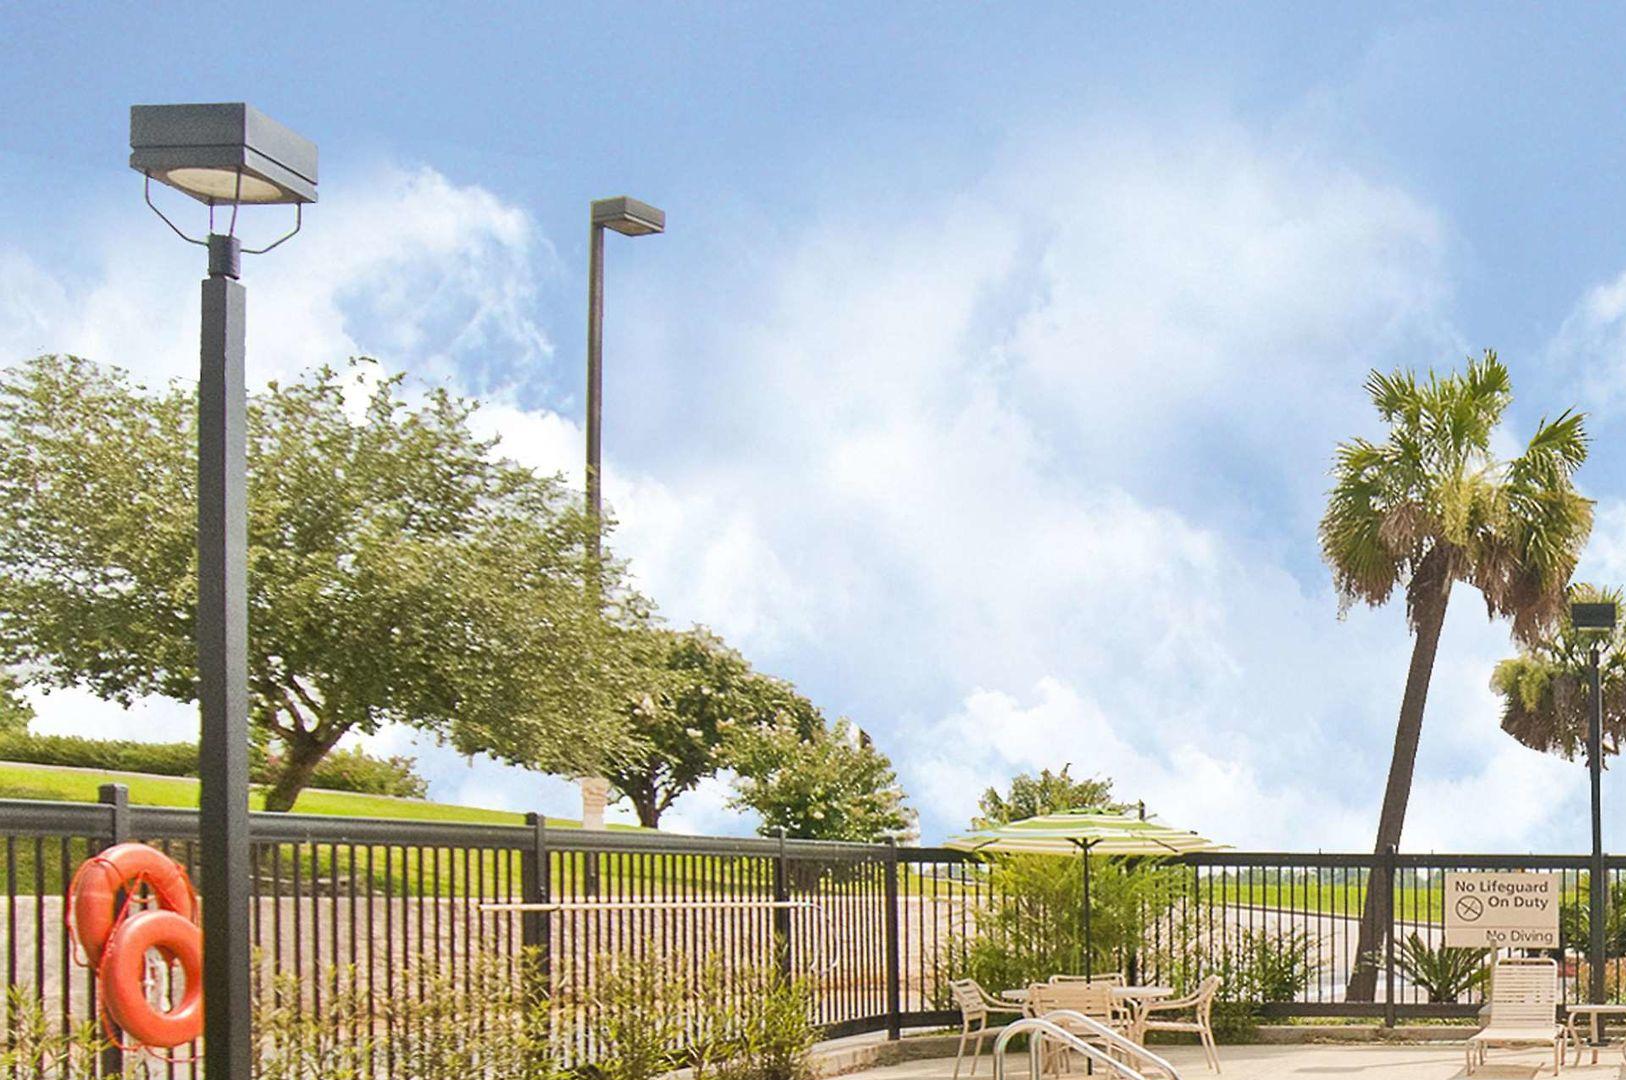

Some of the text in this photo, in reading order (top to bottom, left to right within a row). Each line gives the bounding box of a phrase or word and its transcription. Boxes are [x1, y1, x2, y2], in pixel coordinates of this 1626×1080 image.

[1455, 880, 1548, 895] No Lifeguard
[1488, 896, 1548, 911] On Duty
[1486, 930, 1553, 944] No Diving
